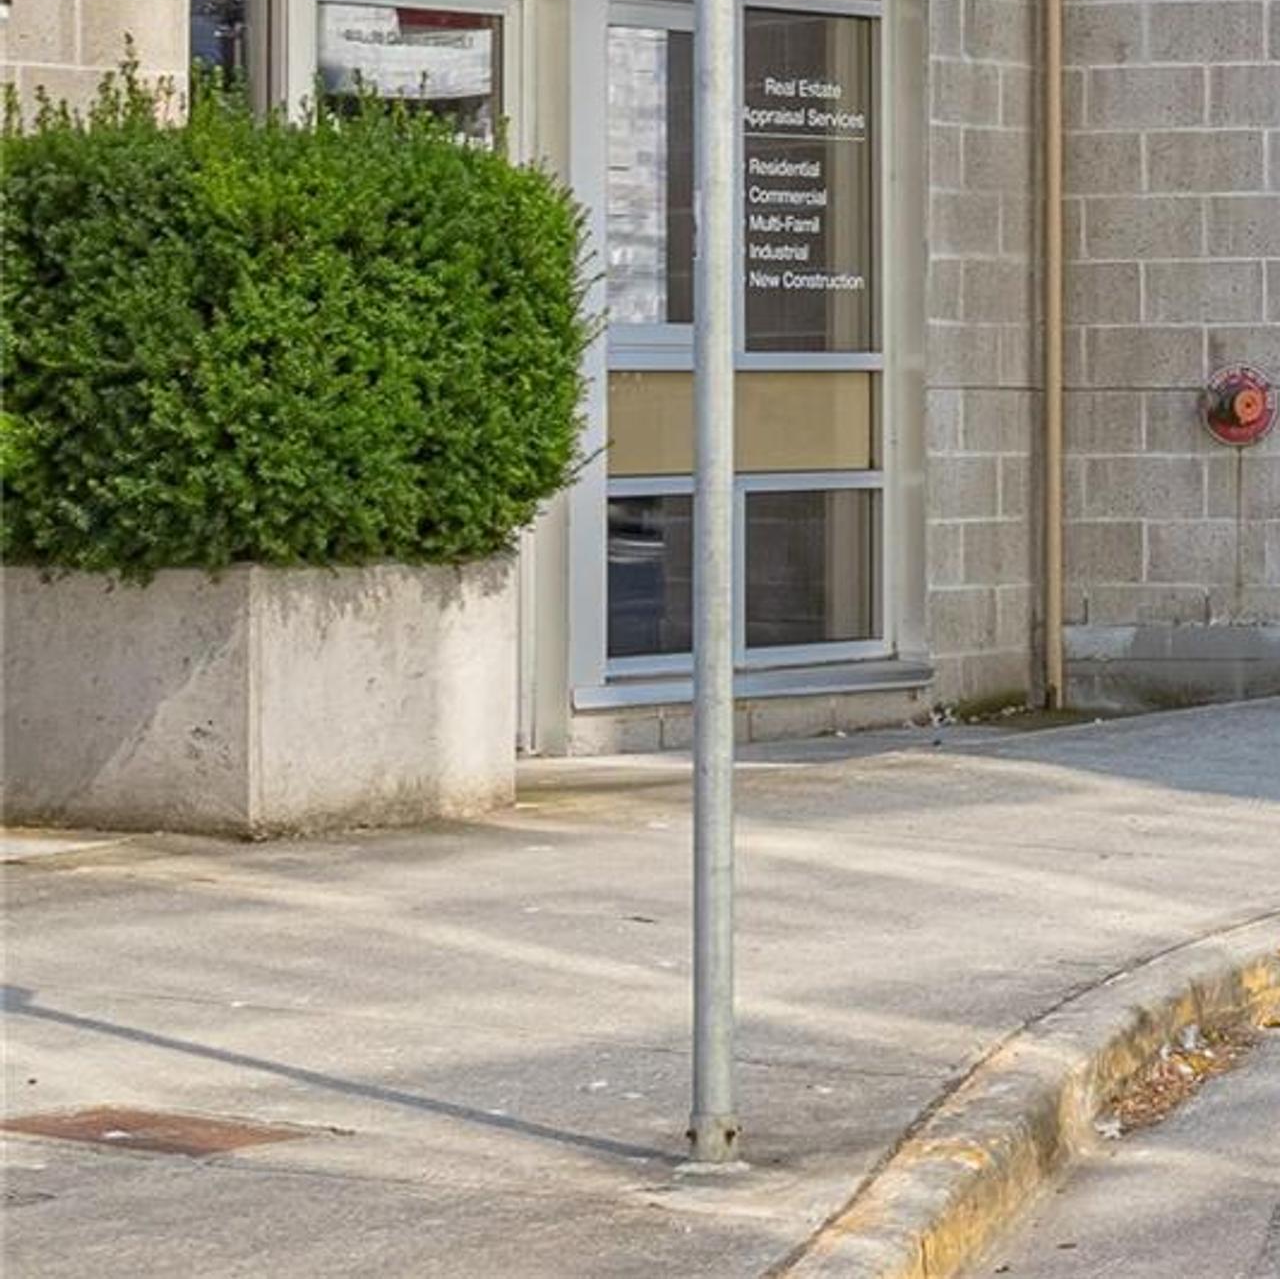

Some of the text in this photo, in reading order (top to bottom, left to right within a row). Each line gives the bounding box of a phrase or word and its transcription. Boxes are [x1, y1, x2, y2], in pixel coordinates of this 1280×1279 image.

[764, 77, 842, 100] Real Estate
[807, 108, 865, 130] Services
[749, 158, 820, 178] Residential
[749, 185, 827, 206] Commercial
[749, 243, 809, 262] Industrial
[749, 271, 865, 292] New Construction
